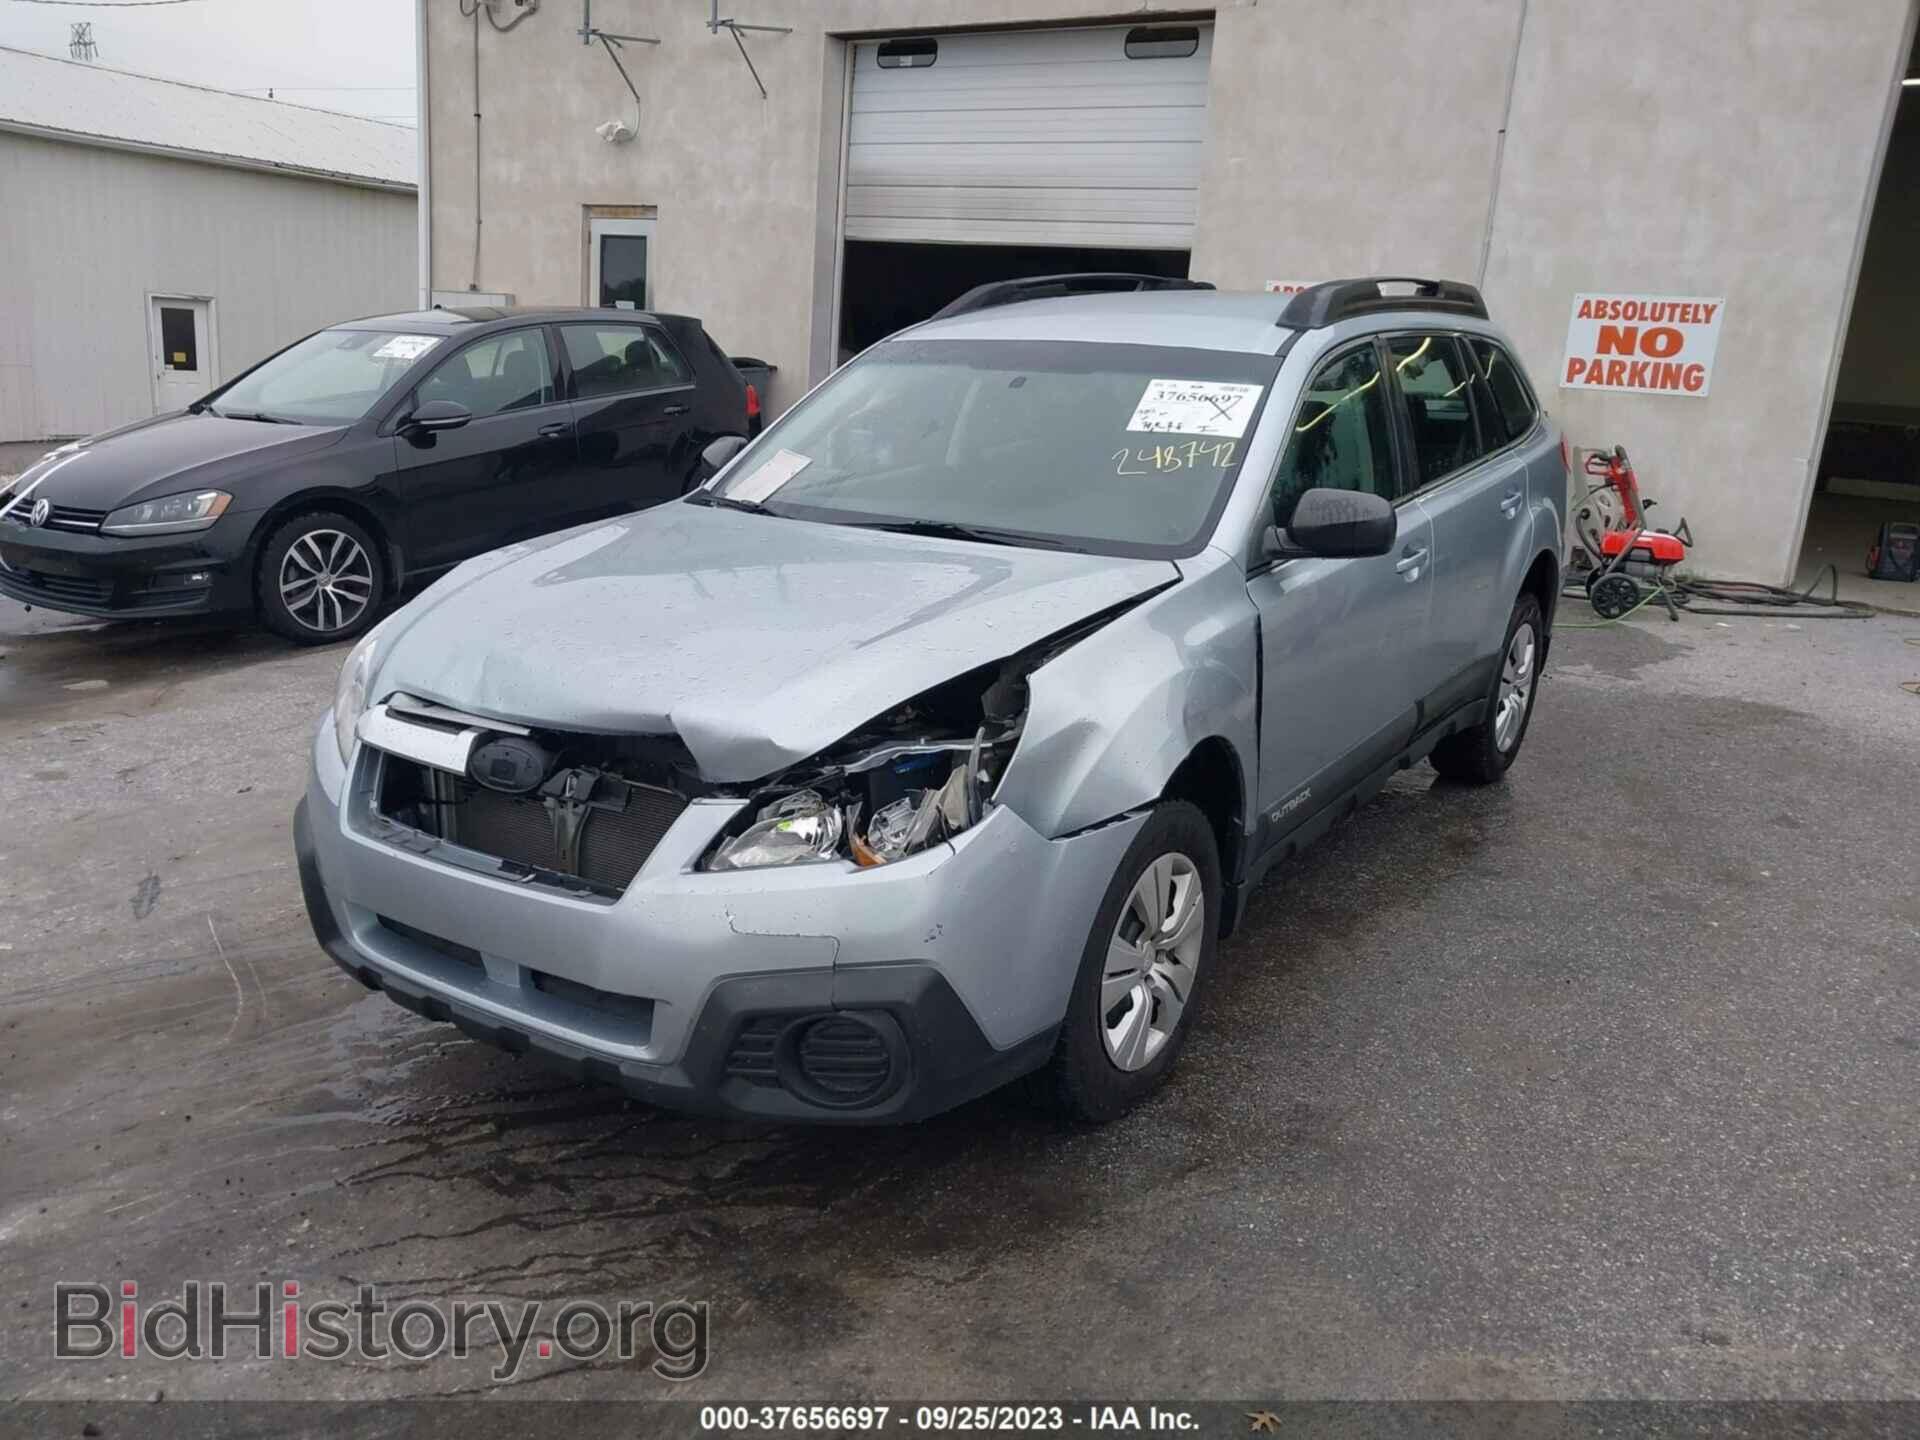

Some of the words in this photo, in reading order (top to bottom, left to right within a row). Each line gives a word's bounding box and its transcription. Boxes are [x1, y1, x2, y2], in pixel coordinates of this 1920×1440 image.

[1577, 298, 1718, 324] ABSOLUTELY
[1597, 325, 1684, 358] NO
[1566, 357, 1705, 392] PARKING
[1271, 787, 1312, 824] OUTBACK
